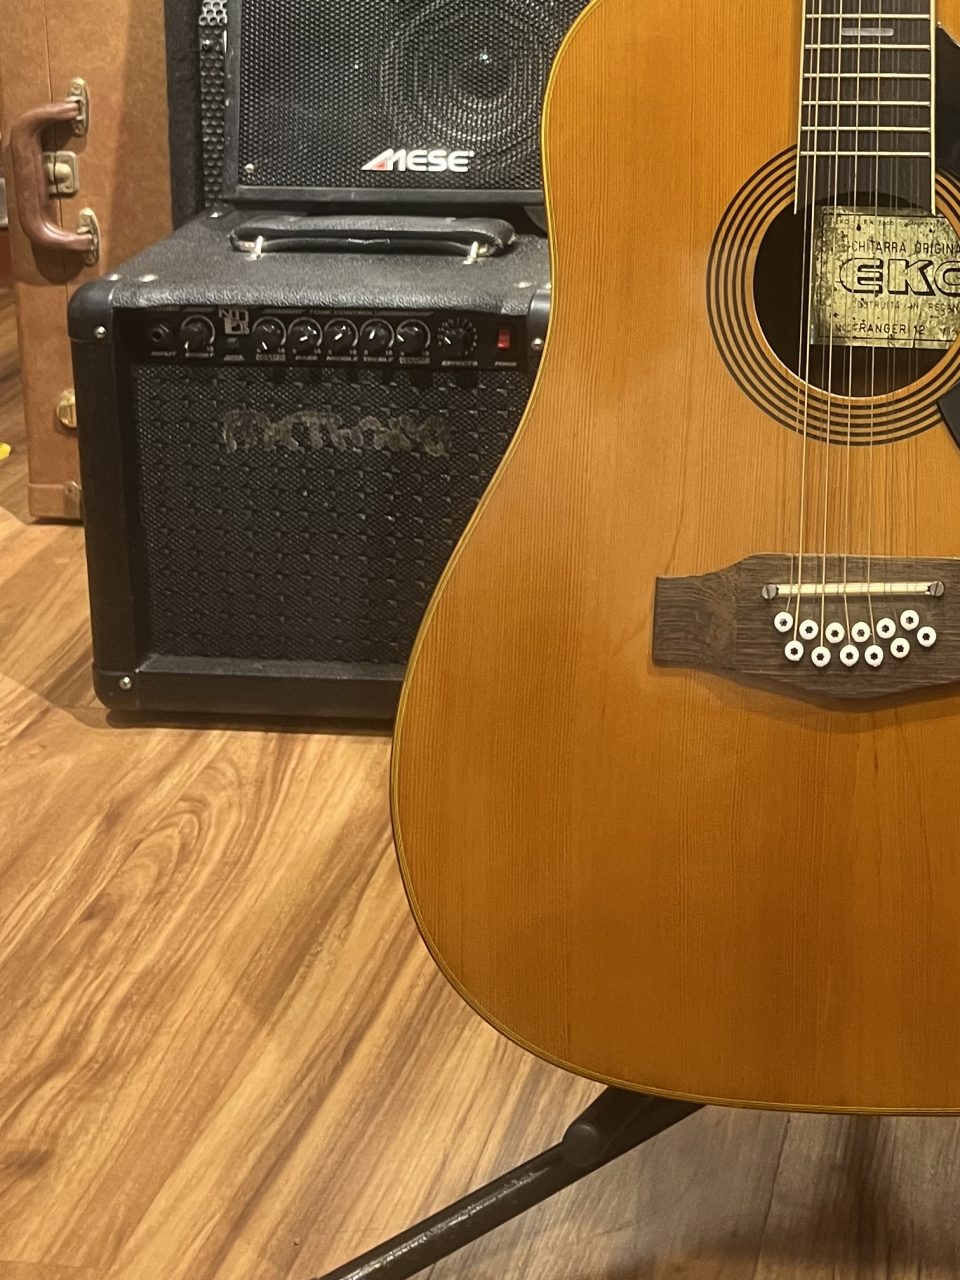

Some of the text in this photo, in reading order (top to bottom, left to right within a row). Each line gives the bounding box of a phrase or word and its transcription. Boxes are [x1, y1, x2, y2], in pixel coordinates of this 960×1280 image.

[361, 148, 471, 173] MESE
[851, 240, 907, 254] CHITARRA
[914, 325, 926, 335] 12
